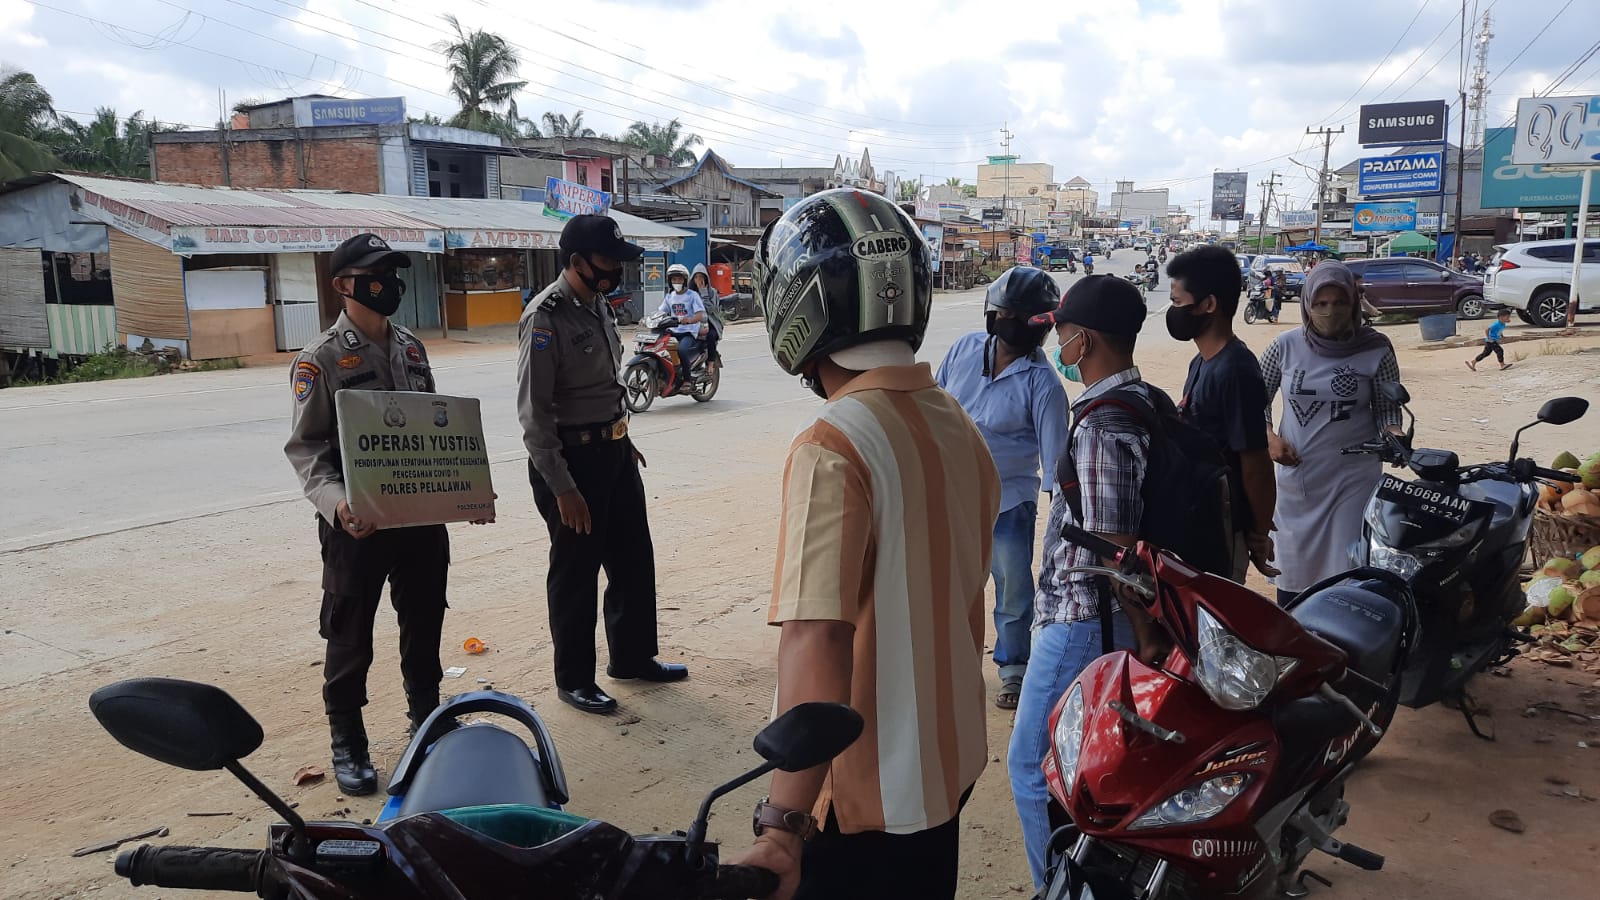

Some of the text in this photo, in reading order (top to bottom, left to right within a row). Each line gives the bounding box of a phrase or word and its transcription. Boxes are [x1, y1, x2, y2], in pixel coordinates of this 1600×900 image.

[314, 105, 366, 120] SAMSUNG
[1368, 114, 1435, 129] SAMSUNG
[1363, 157, 1438, 173] PRATAMA
[1412, 171, 1437, 179] COMM
[554, 182, 602, 206] AMPERA
[558, 200, 595, 215] SAIYO
[205, 228, 249, 243] NASI
[253, 228, 322, 243] GORENG
[471, 231, 560, 249] AMPERA
[857, 237, 907, 256] CABERG
[358, 434, 481, 452] OPERASI YUSTISI
[354, 459, 399, 468] PENDISIPLINAN
[392, 470, 432, 479] PENCEGAHAN
[433, 470, 451, 478] COVID
[380, 480, 472, 495] POLRES PELALAWAN
[1383, 478, 1470, 512] BM 5068 AAN
[1194, 751, 1268, 775] Jupiter
